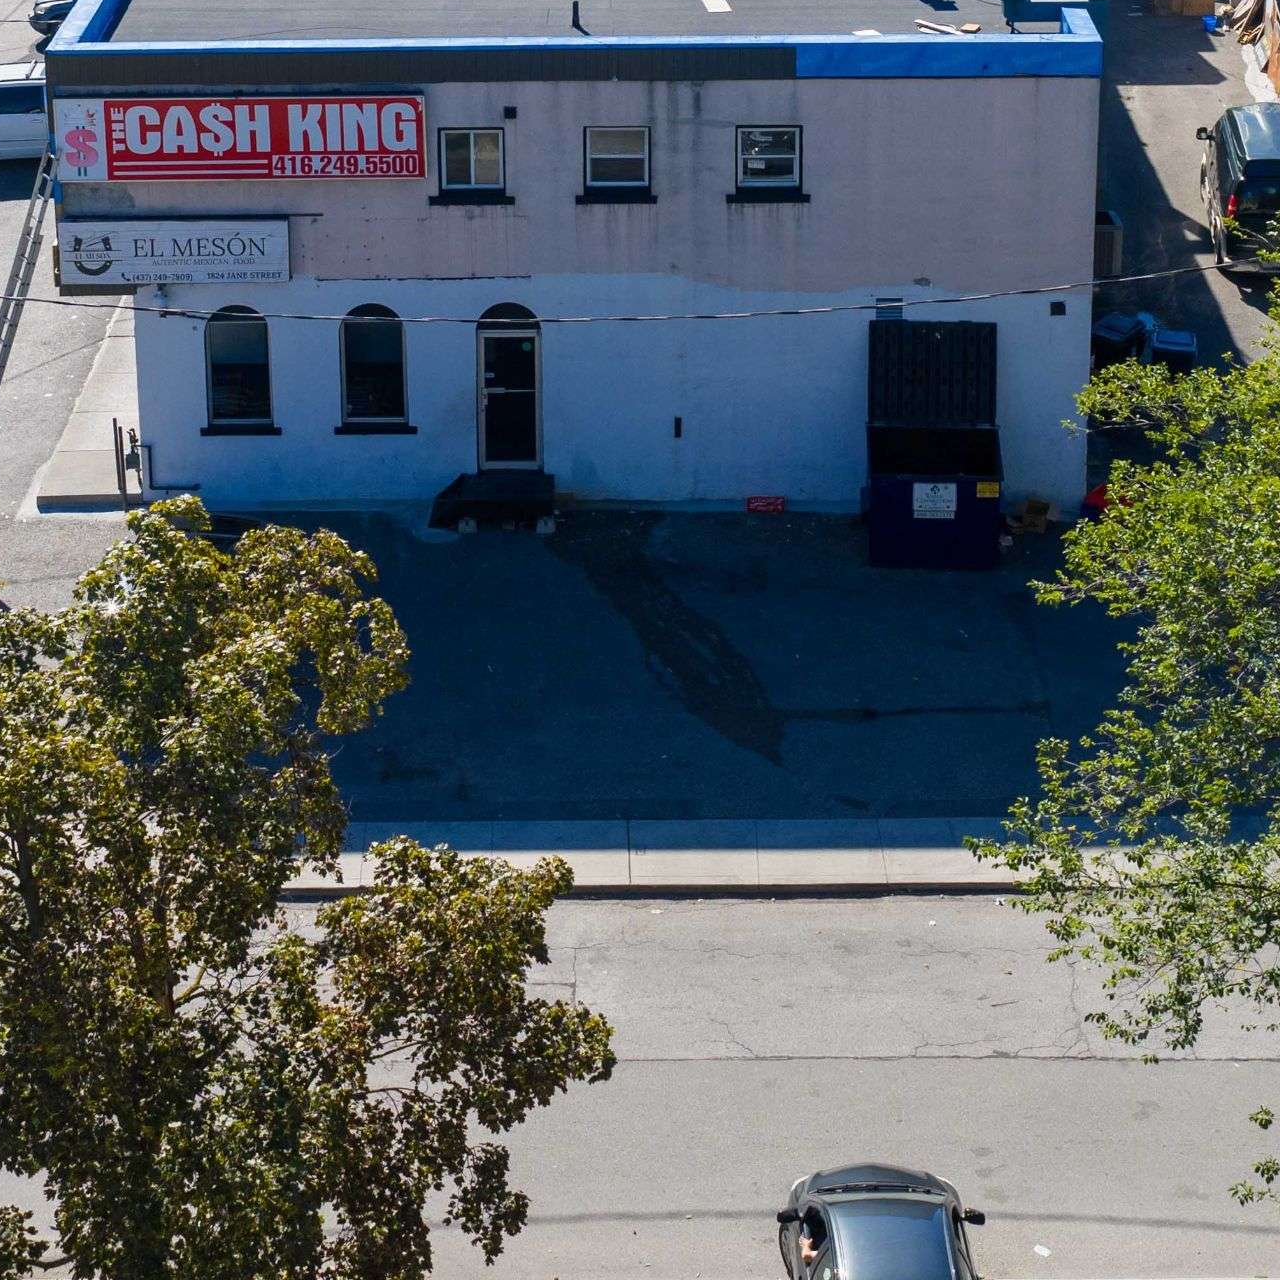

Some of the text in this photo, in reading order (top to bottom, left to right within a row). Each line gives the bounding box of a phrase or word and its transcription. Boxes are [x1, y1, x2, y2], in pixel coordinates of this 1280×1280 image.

[110, 106, 126, 154] THE
[288, 102, 419, 153] KING
[273, 154, 419, 176] 416.249.5500
[133, 232, 267, 258] EL MESÓN
[233, 257, 255, 265] FOOD
[226, 271, 249, 279] JANE
[250, 271, 283, 279] STREET
